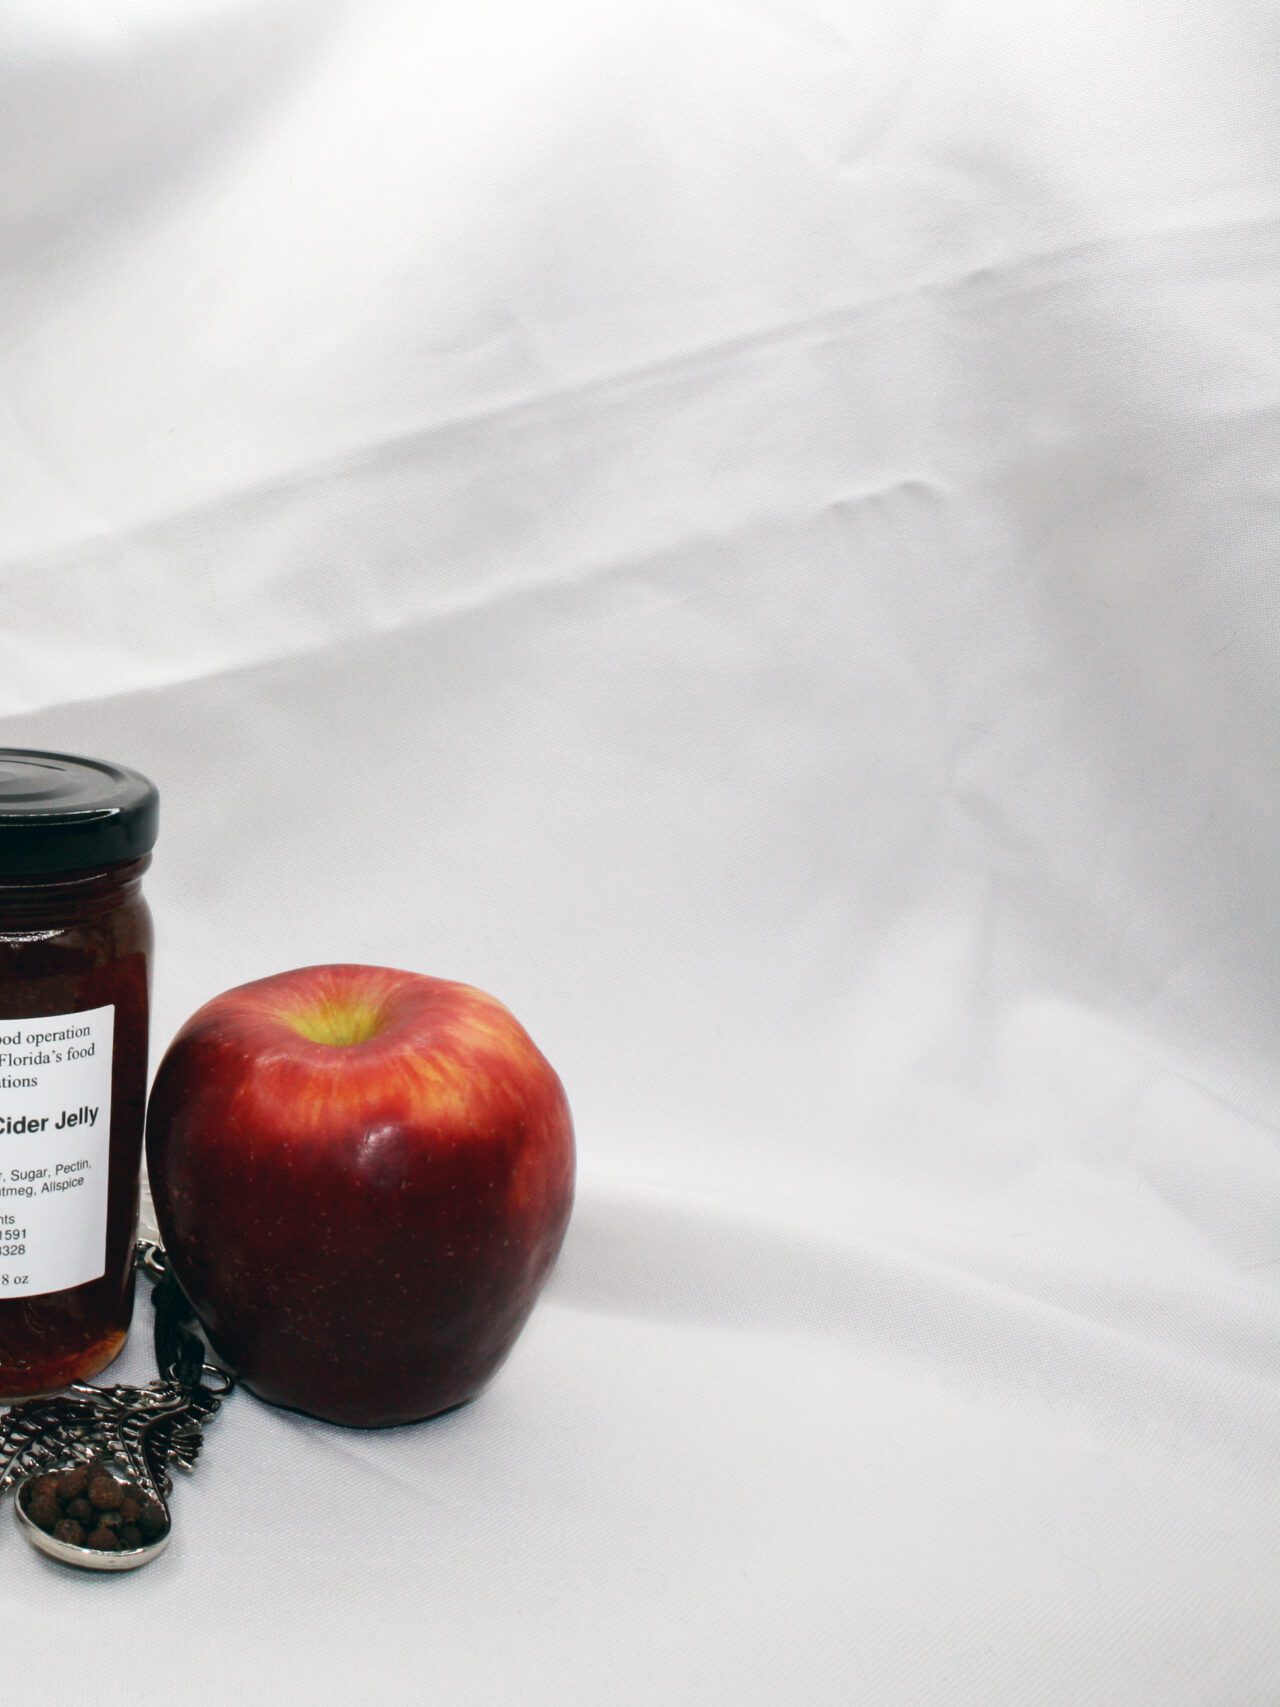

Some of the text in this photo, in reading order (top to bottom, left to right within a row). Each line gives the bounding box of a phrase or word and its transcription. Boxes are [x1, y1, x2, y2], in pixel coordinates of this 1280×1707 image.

[25, 1025, 91, 1048] operation
[66, 1042, 96, 1061] food
[54, 1105, 100, 1130] Jelly
[10, 1168, 52, 1183] Sugar,
[40, 1176, 85, 1194] Allspice
[1, 1273, 10, 1286] 8
[13, 1276, 30, 1286] oz
